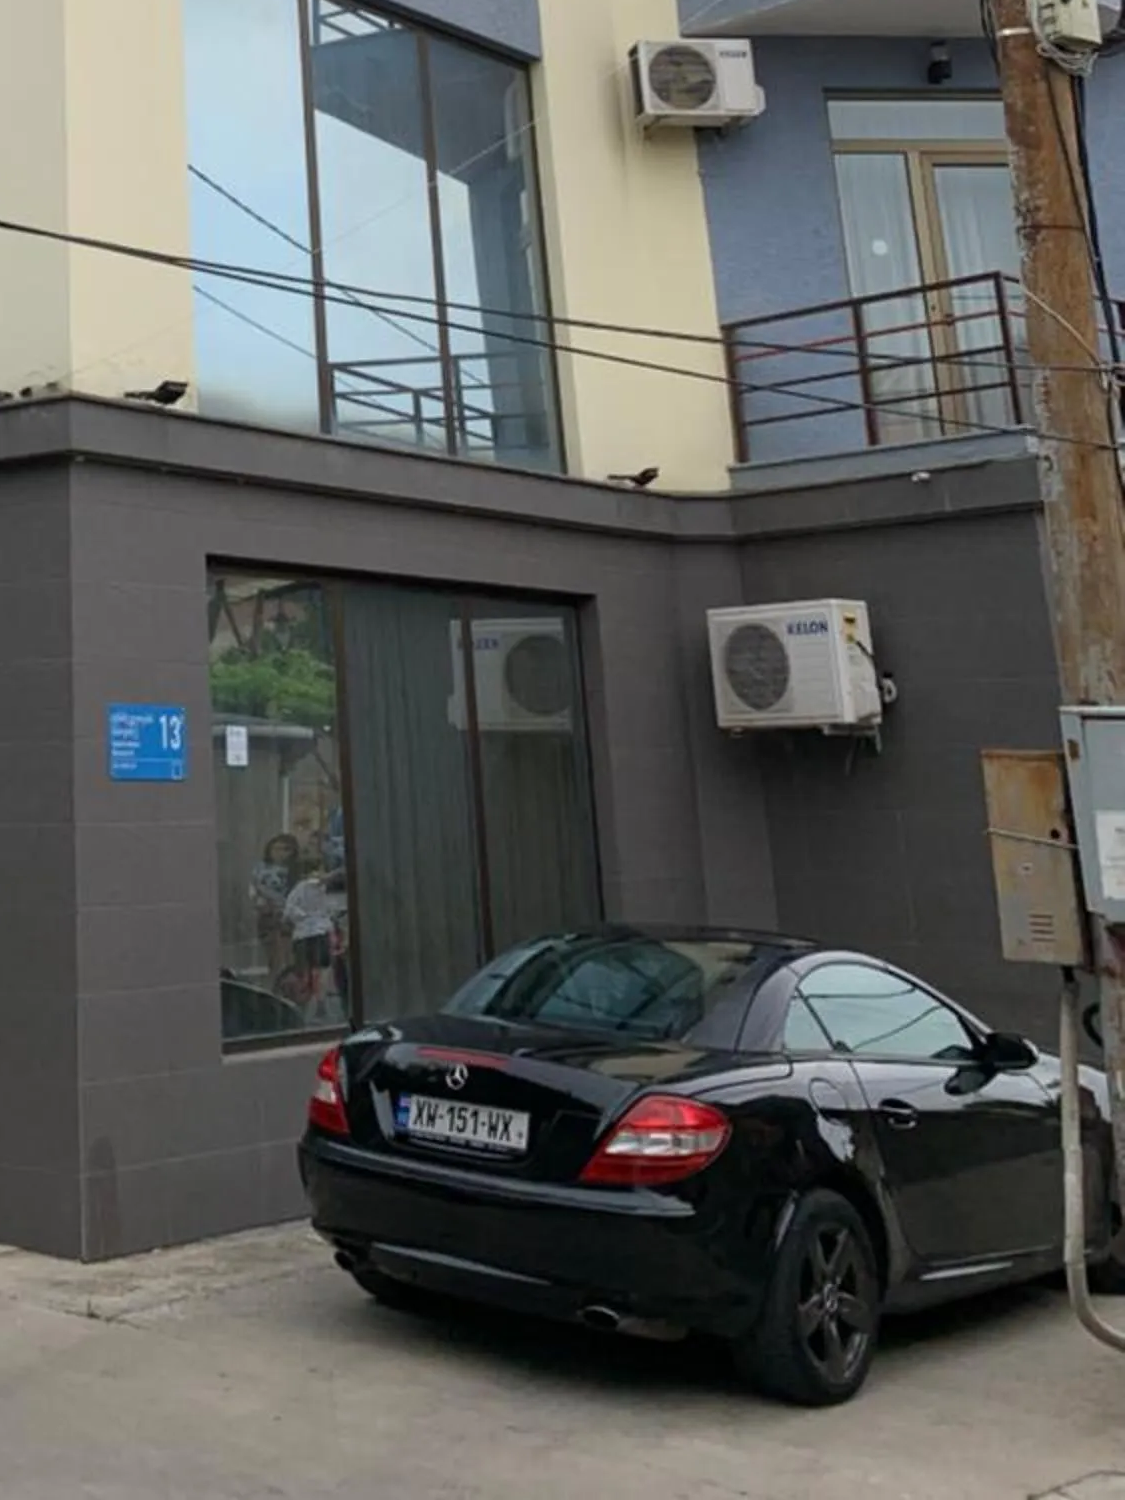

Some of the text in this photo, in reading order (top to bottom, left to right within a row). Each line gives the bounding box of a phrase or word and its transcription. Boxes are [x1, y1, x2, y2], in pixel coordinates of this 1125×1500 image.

[786, 619, 829, 636] KELON
[159, 714, 182, 751] 13
[413, 1097, 513, 1142] XW-151-WX
